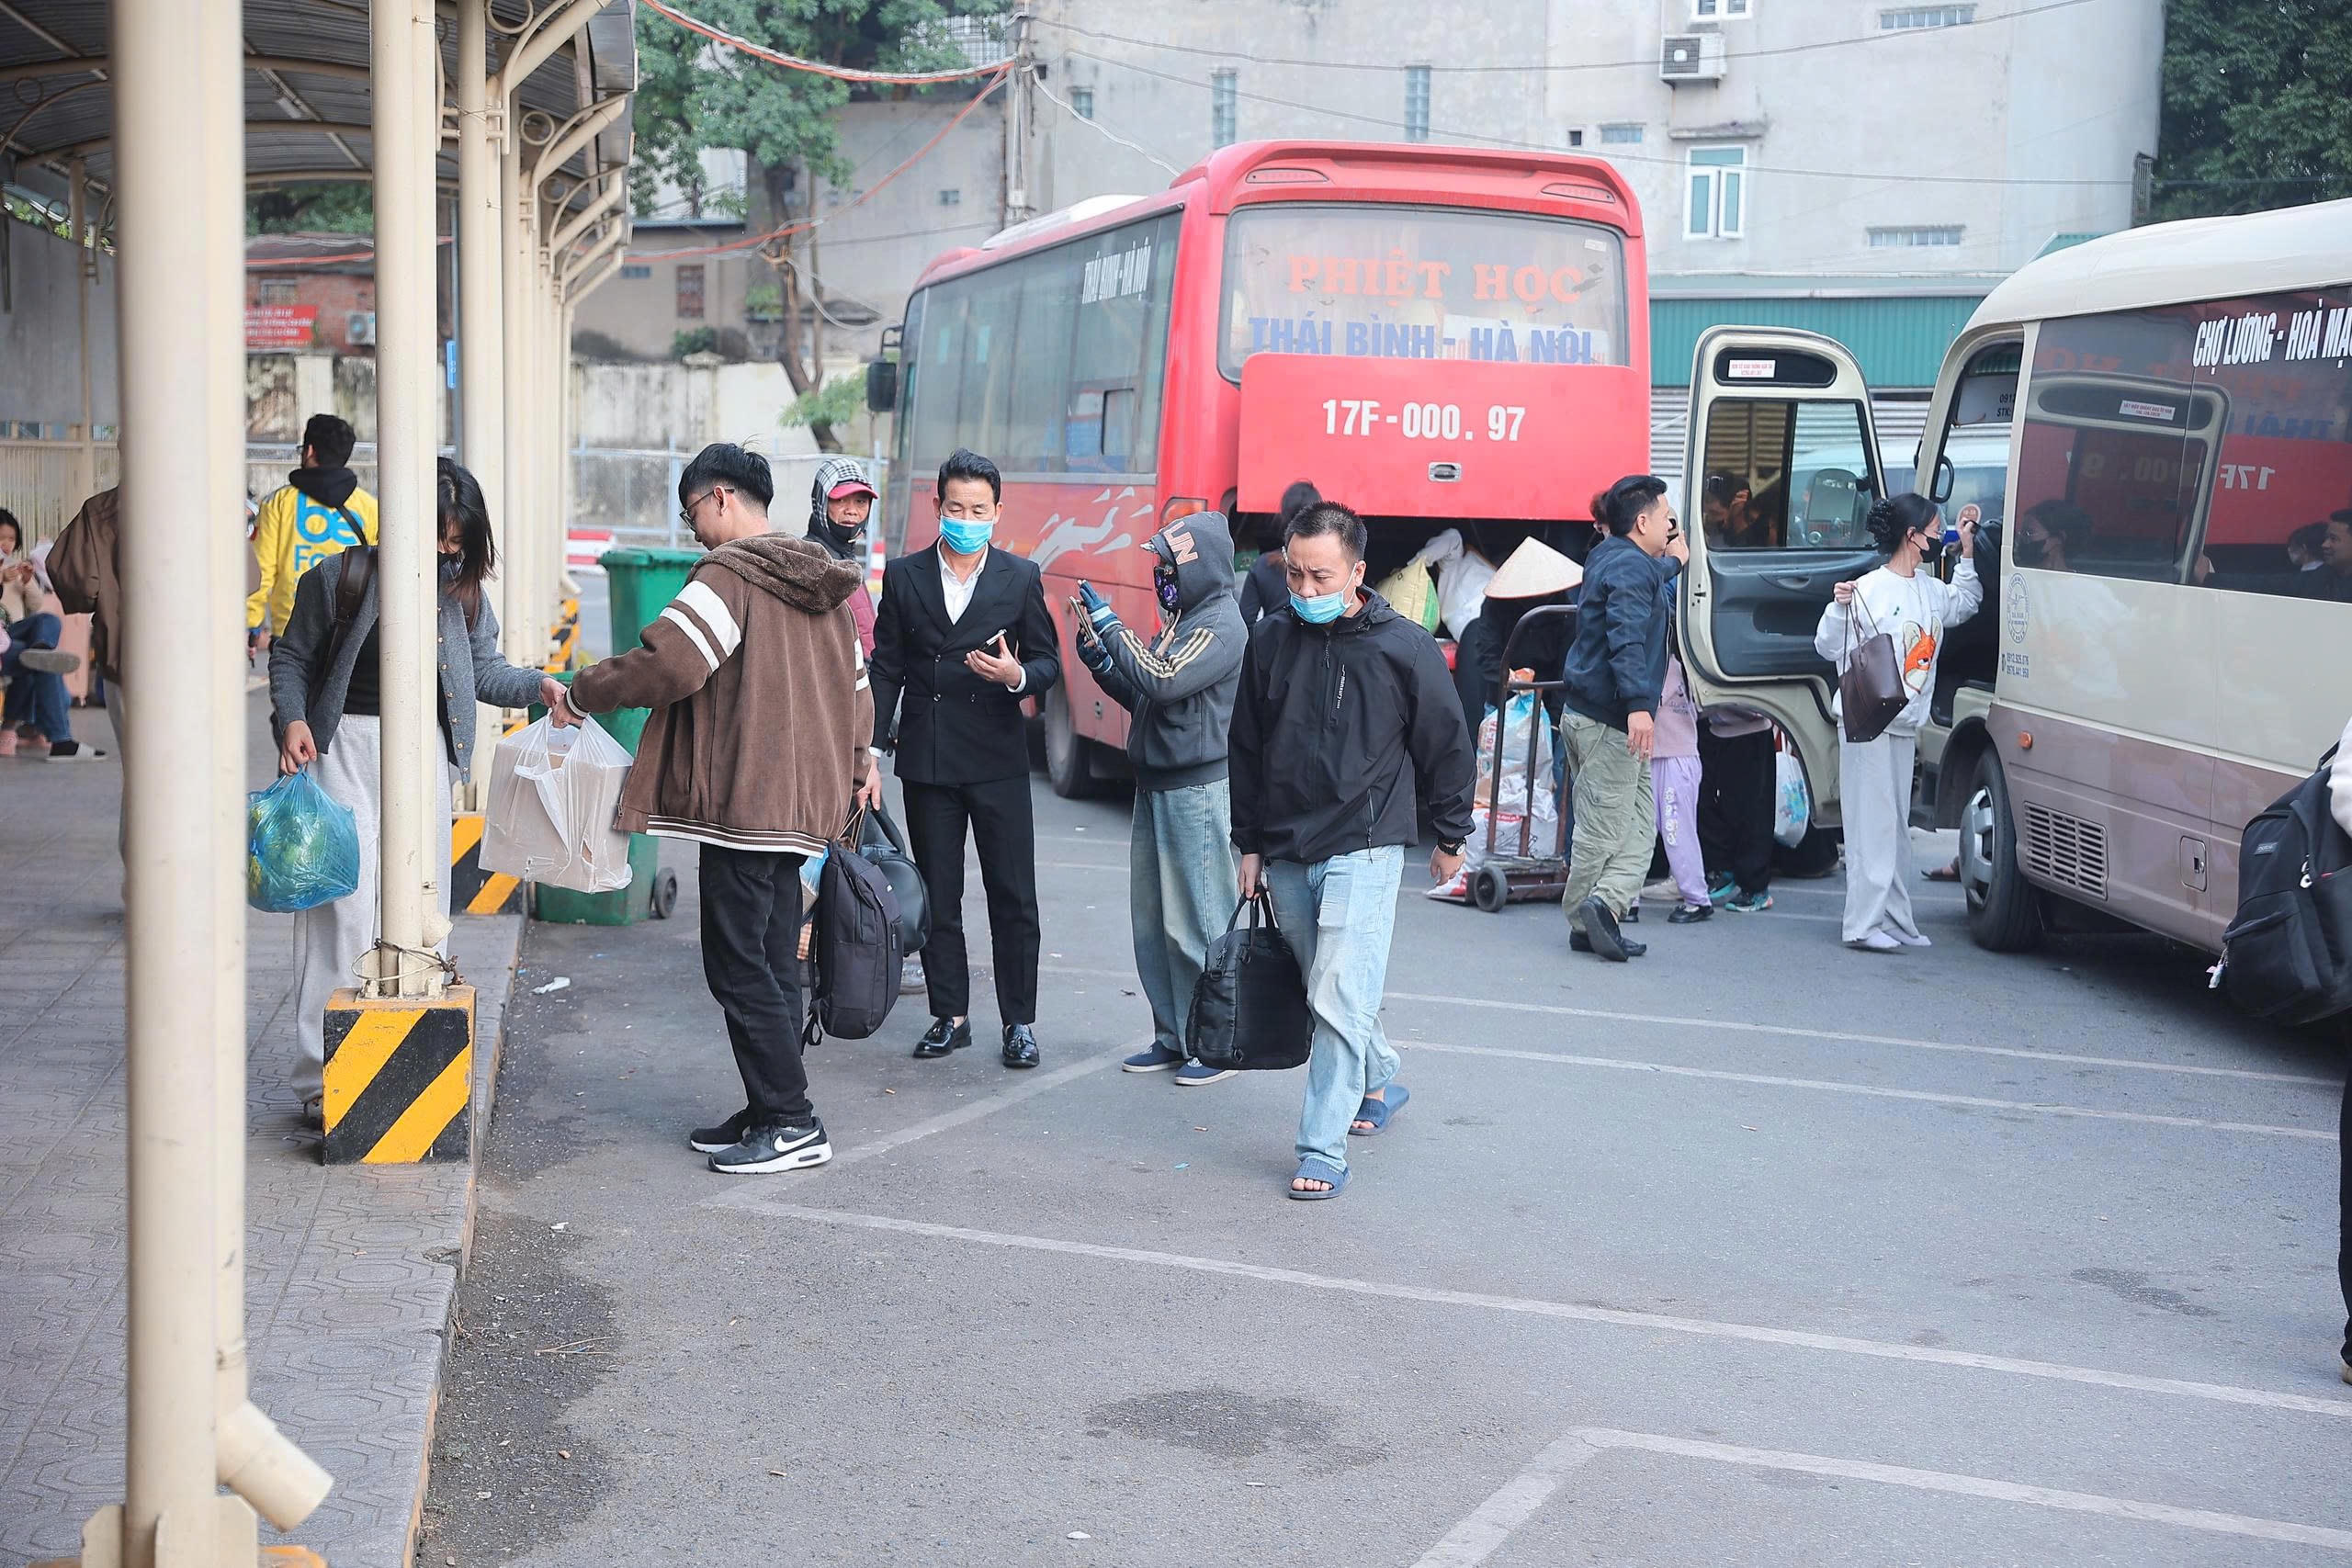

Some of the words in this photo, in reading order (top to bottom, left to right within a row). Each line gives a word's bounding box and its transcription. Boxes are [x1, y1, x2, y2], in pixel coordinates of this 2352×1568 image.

[1288, 246, 1451, 307] PHIỆT
[1472, 264, 1585, 316] HỌC
[1248, 310, 1332, 355] THÁI
[1346, 313, 1435, 358] BÌNH
[1470, 319, 1519, 363] HÀ
[2192, 315, 2228, 375] CHỢ
[1487, 404, 1526, 442] 97
[297, 491, 365, 545] be
